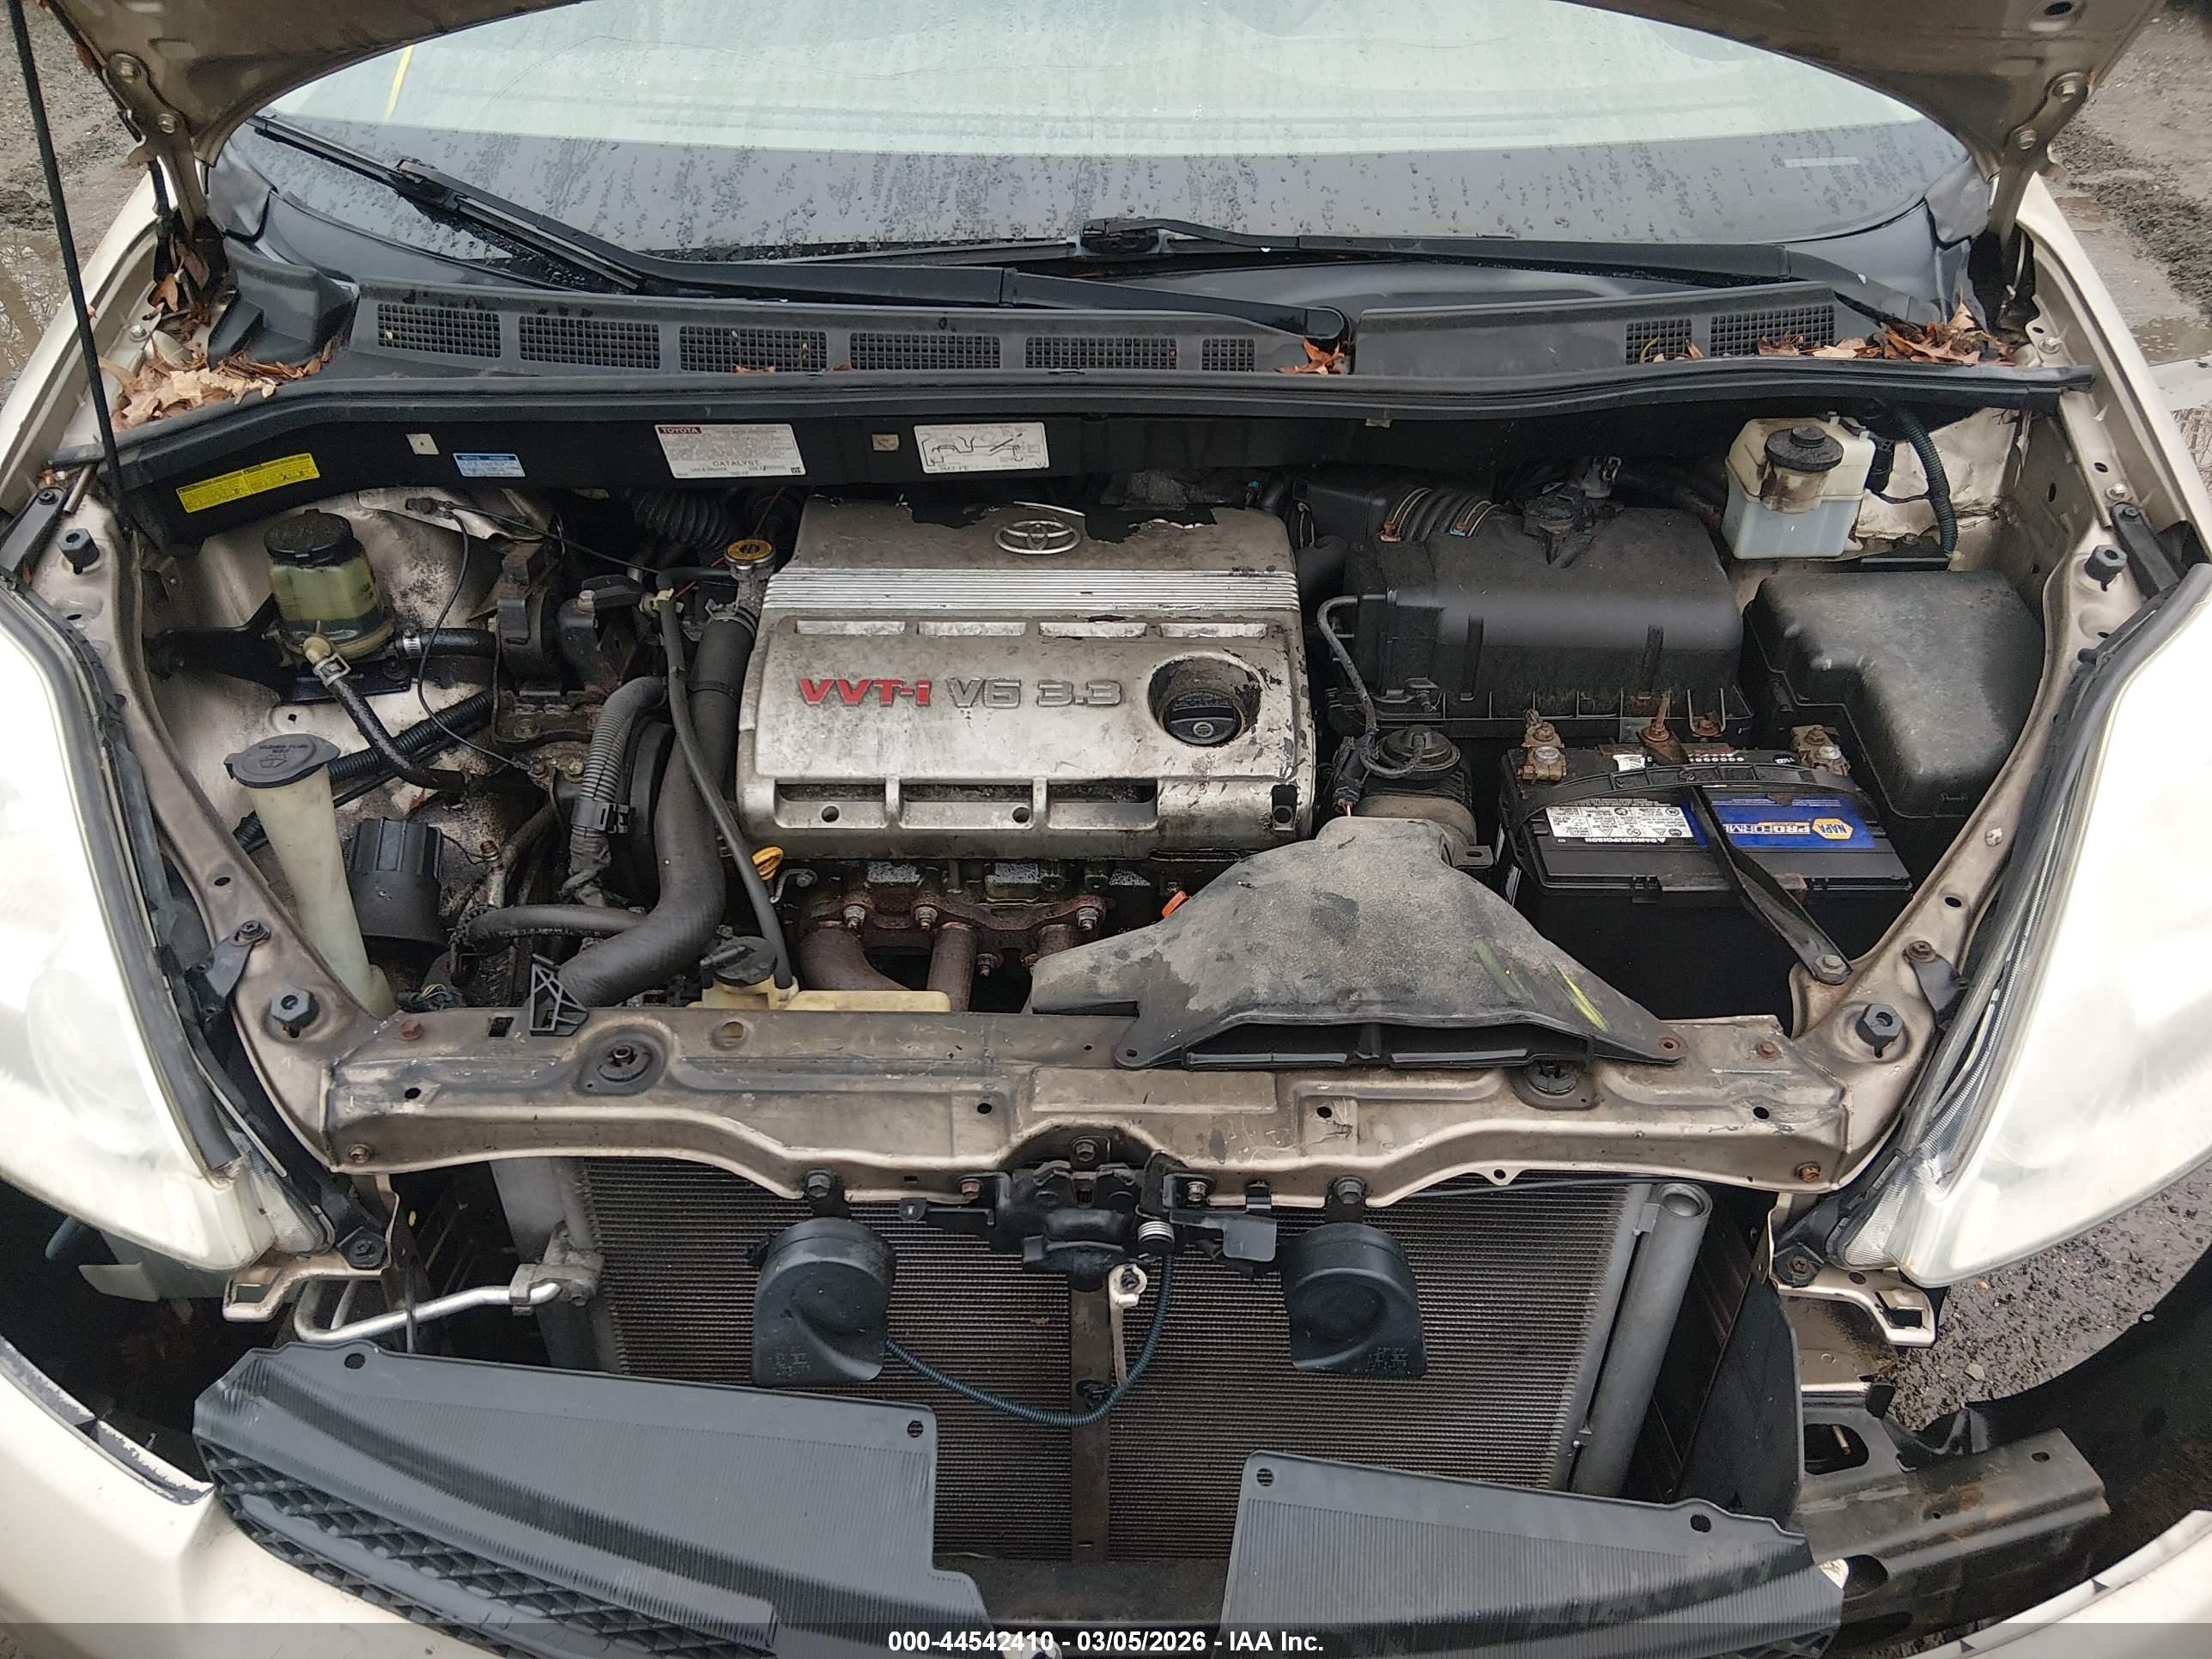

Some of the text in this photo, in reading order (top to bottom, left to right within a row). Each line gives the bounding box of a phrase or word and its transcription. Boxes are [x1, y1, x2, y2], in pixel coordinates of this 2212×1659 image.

[798, 678, 1121, 709] VVT-i V6 3.3
[1816, 823, 1848, 835] NAPA
